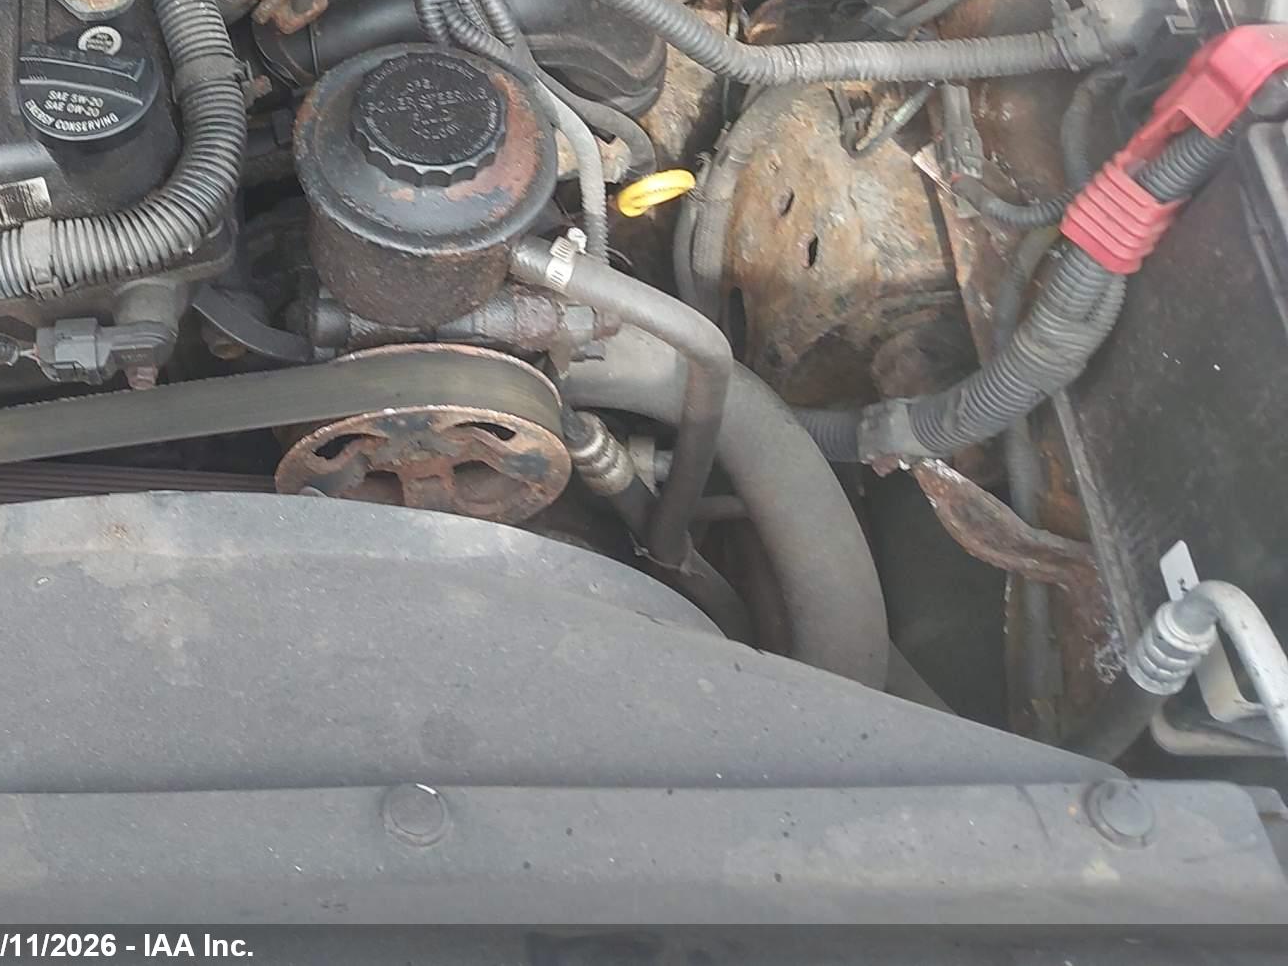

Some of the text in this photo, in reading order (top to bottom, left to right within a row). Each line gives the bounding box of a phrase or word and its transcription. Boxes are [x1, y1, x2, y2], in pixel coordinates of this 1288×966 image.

[44, 100, 66, 112] SAE
[48, 90, 104, 108] SAE 5W-20
[25, 99, 119, 132] ENERGY CONSERVING
